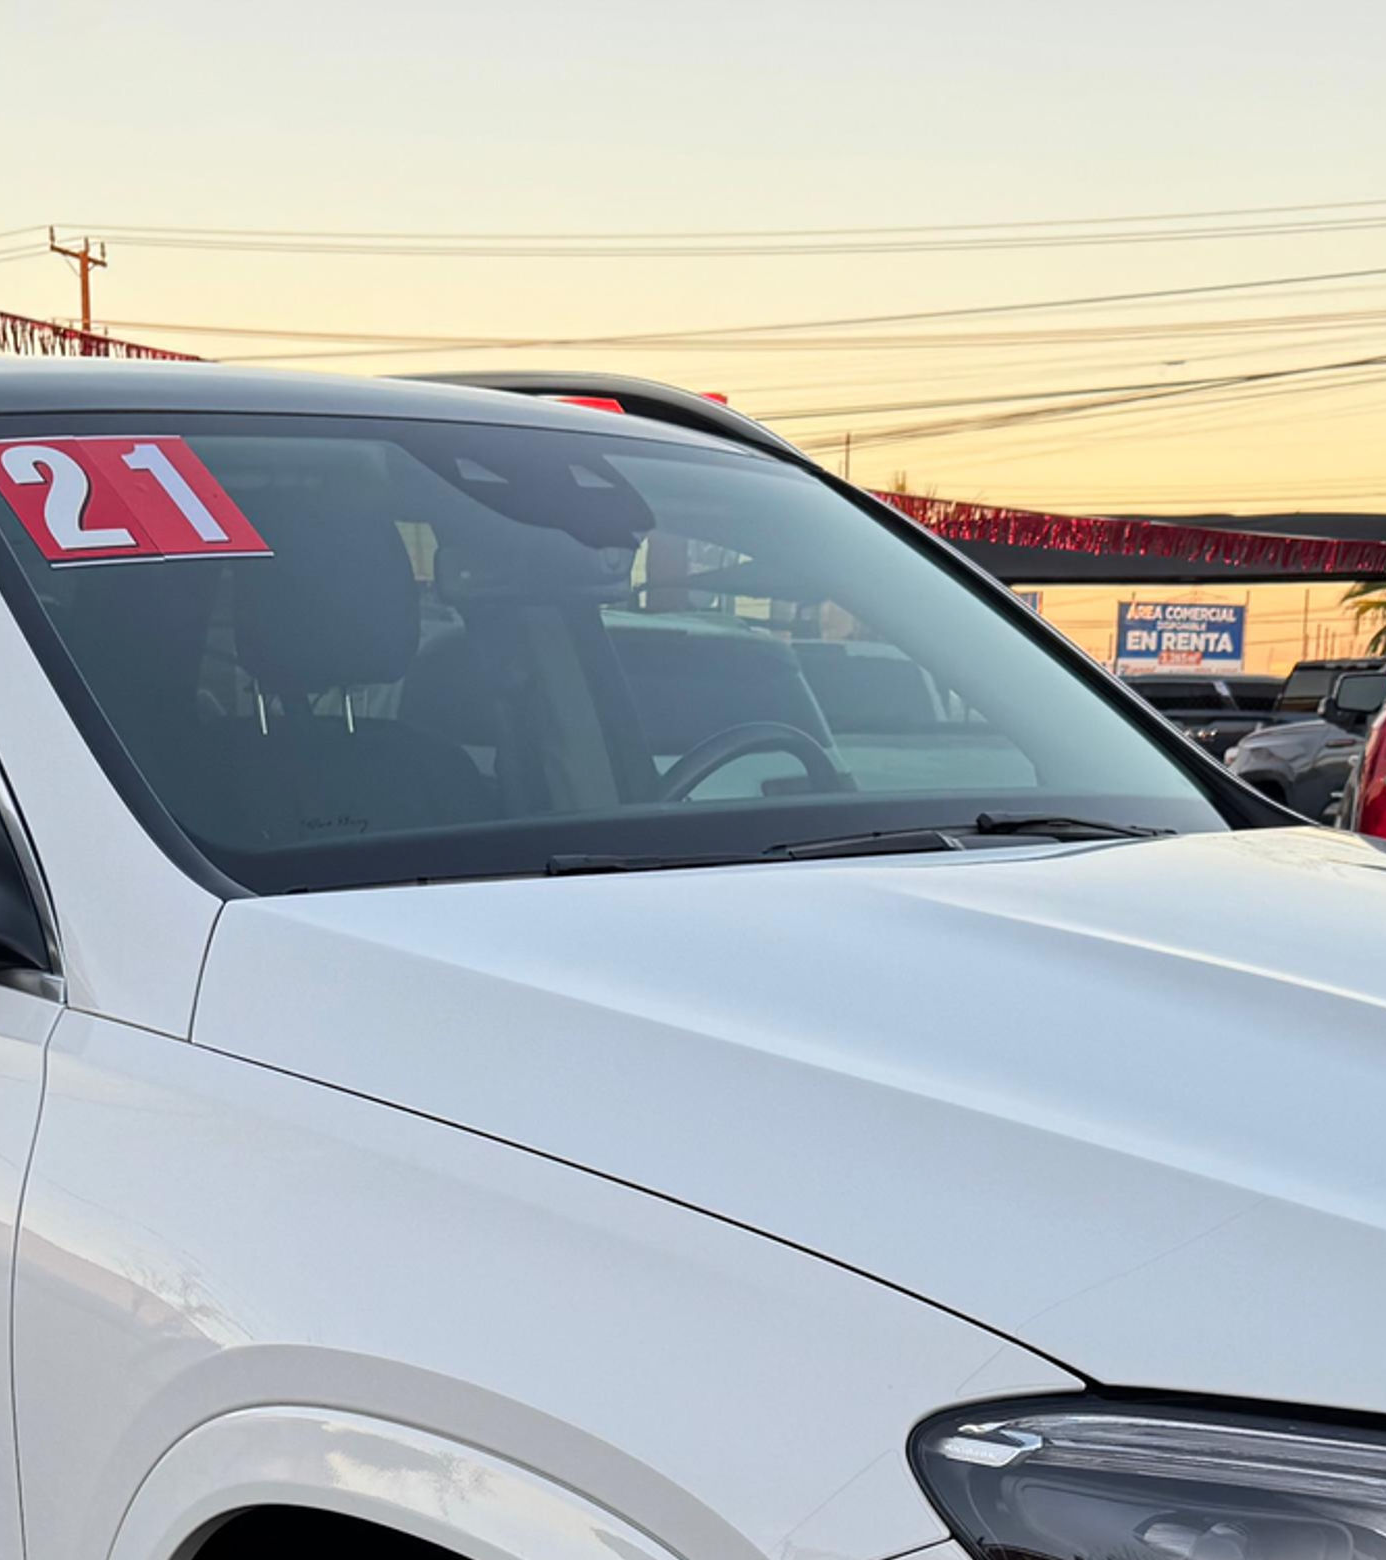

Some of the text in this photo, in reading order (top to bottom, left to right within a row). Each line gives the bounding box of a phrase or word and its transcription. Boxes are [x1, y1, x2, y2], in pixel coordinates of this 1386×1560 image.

[1165, 605, 1237, 623] COMERCIAL
[1126, 629, 1233, 653] EN RENTA
